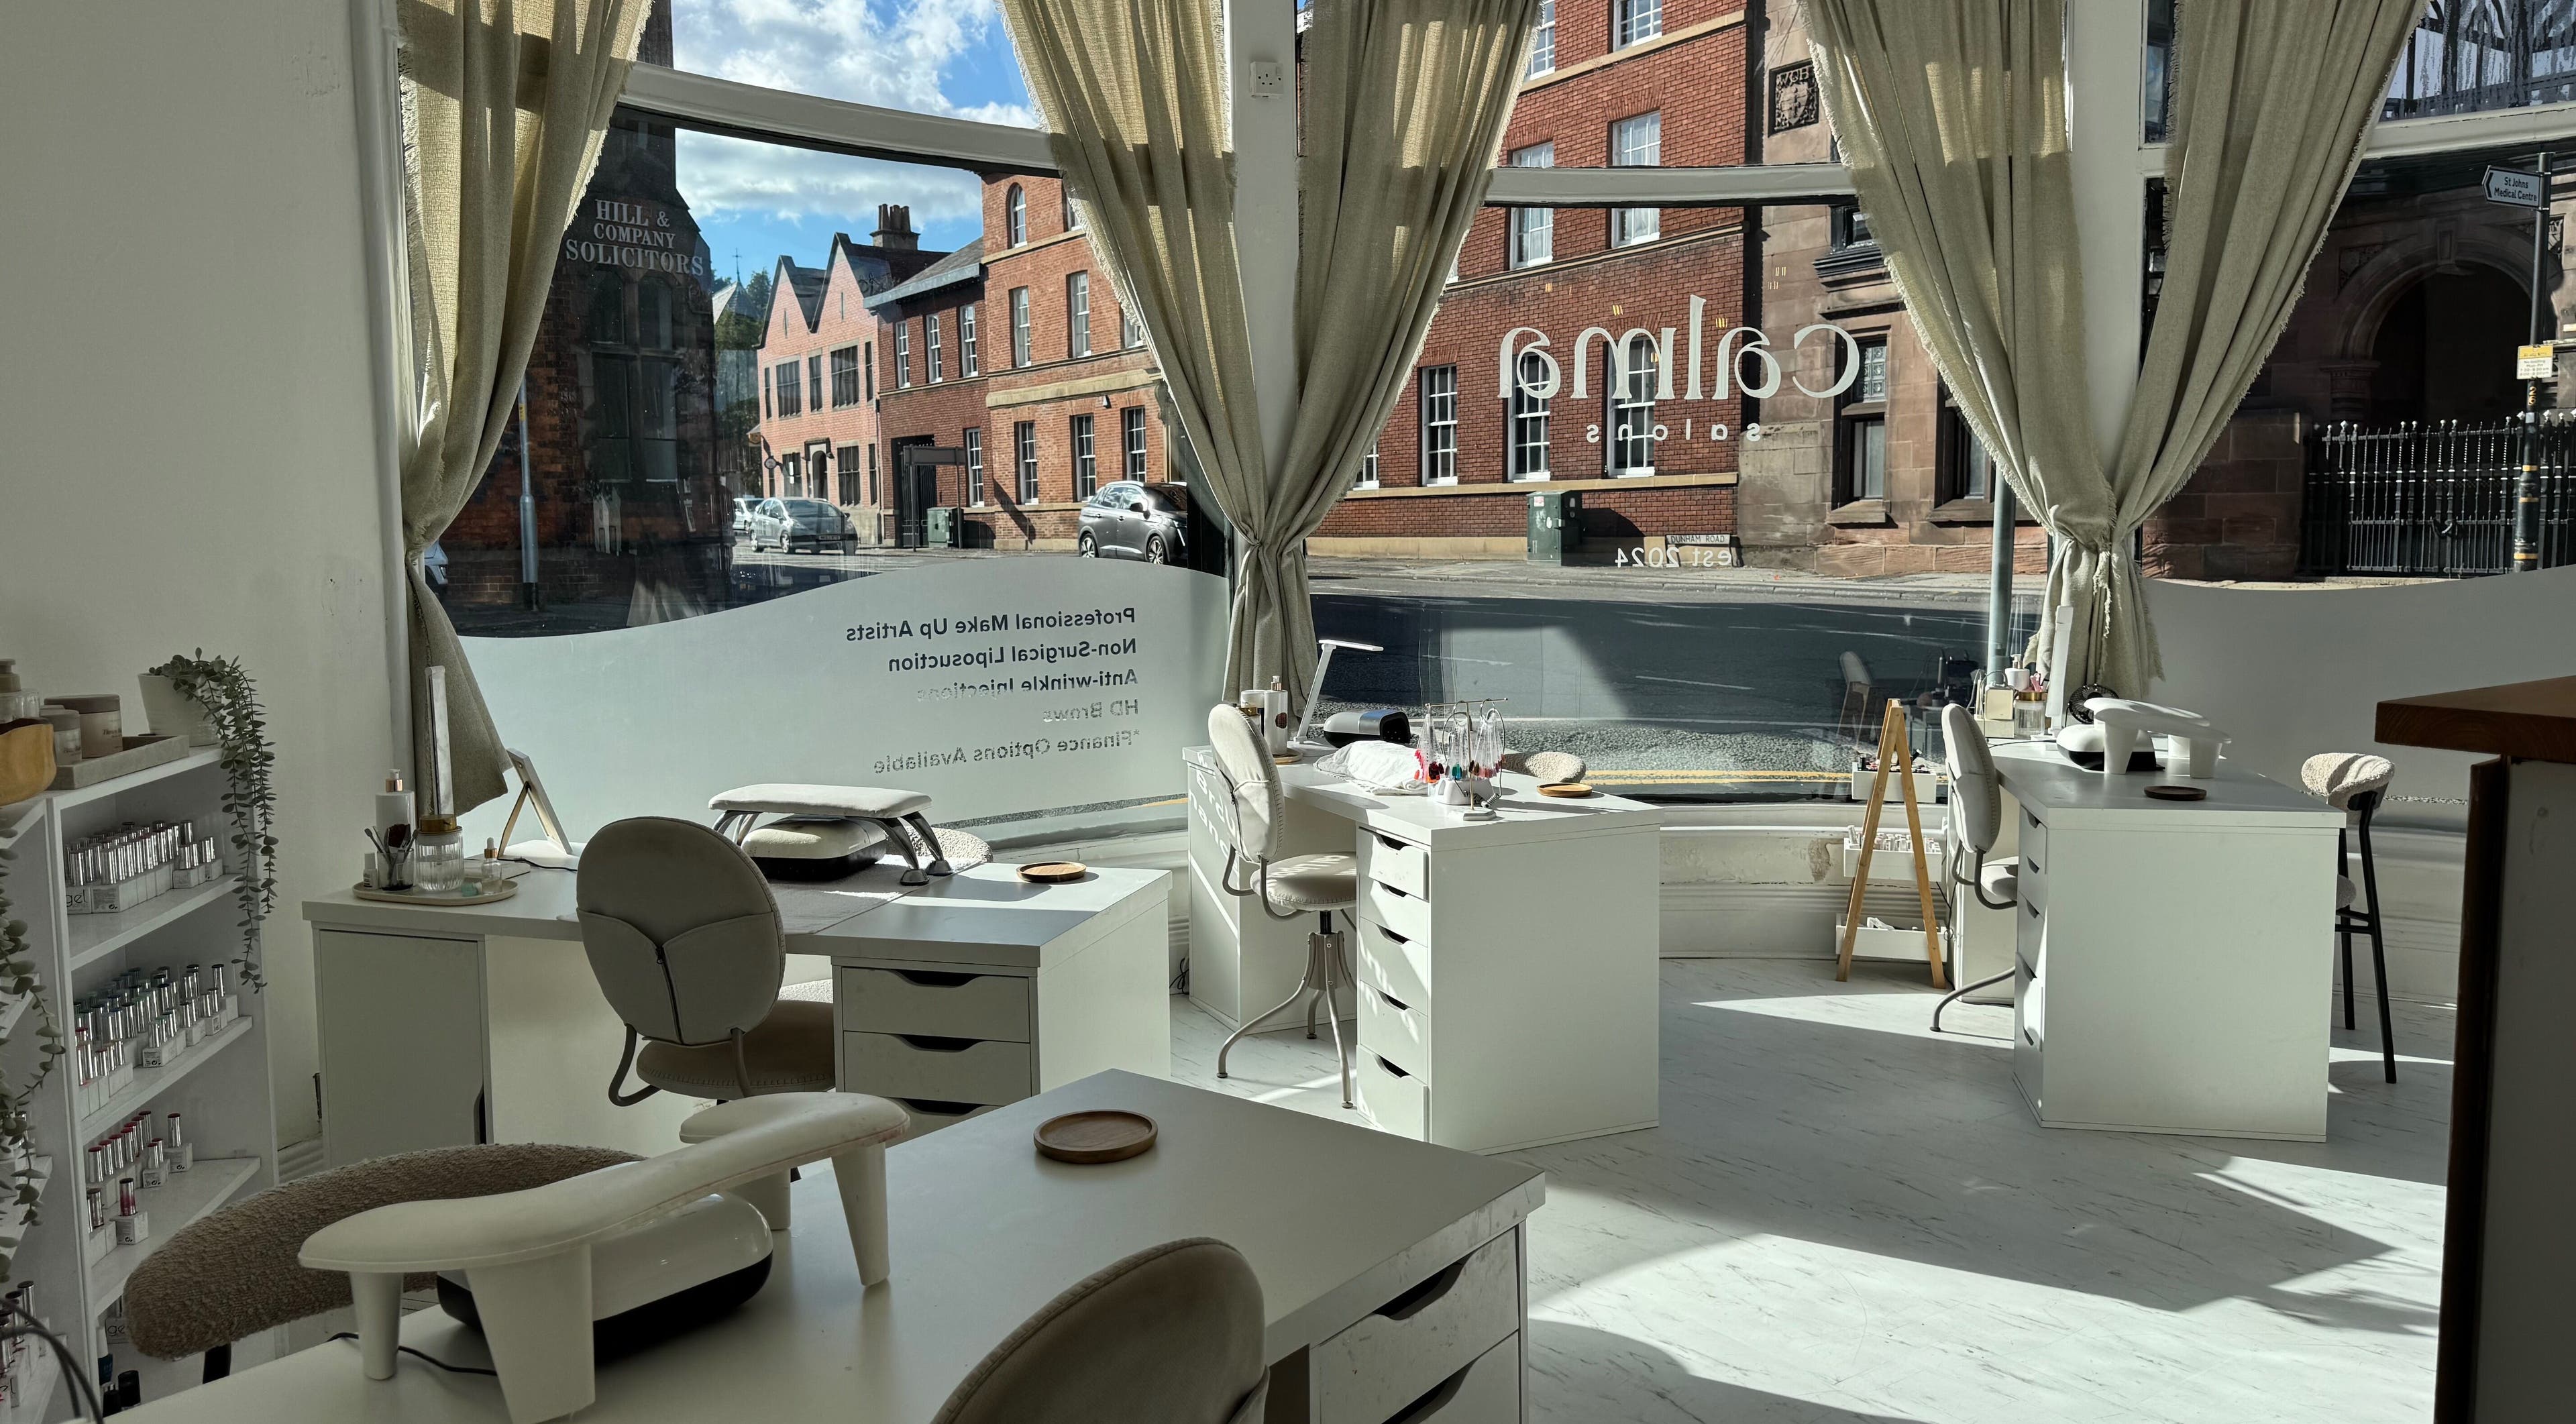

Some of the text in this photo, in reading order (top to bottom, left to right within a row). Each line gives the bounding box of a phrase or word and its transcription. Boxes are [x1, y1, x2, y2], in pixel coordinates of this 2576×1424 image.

[2504, 176, 2528, 188] St Johns
[2494, 187, 2537, 201] Medical Centre
[595, 199, 669, 227] HILL &
[594, 223, 676, 249] COMPANY
[566, 239, 704, 276] SOLICITORS
[1671, 535, 1701, 543] DUNHAM
